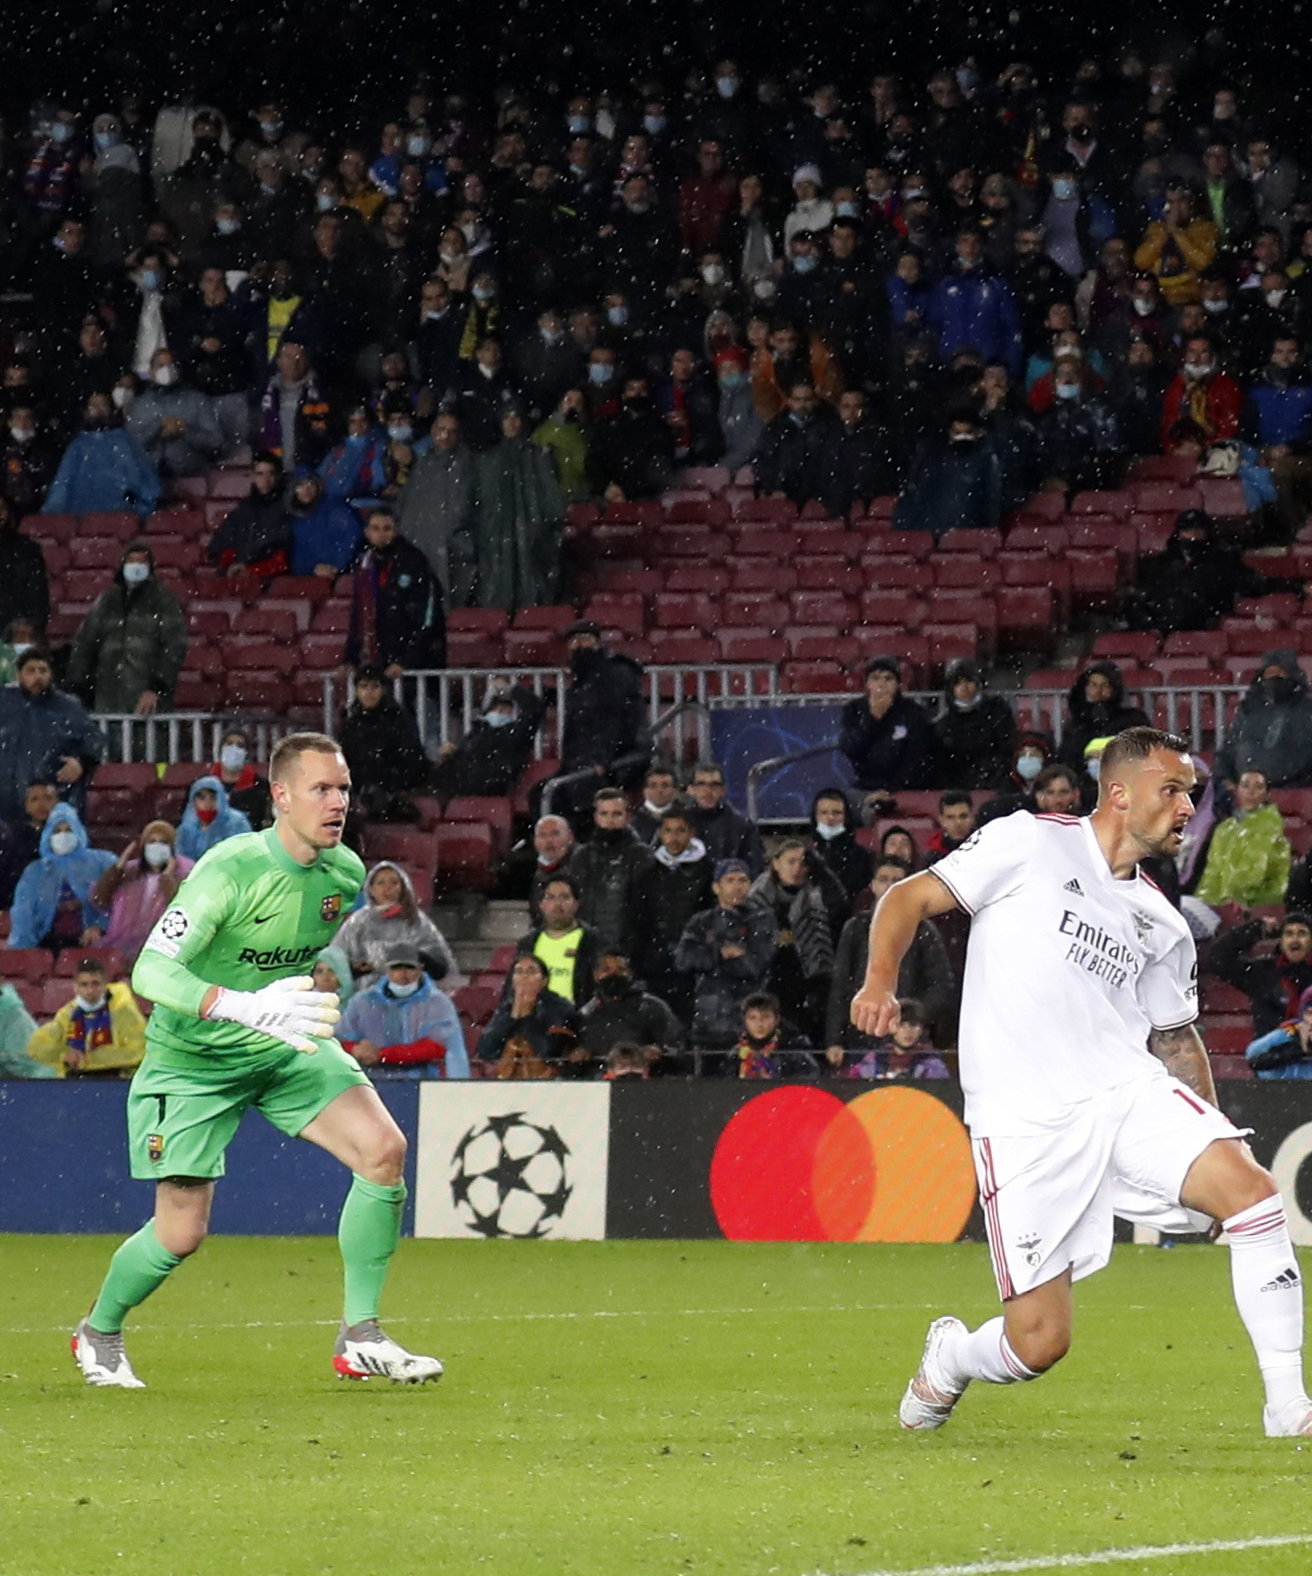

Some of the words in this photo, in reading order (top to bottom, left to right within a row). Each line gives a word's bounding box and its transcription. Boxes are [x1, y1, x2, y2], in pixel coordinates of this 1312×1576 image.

[238, 944, 331, 965] Rakute
[1058, 910, 1139, 975] Emirates
[1065, 943, 1092, 966] FLY
[1087, 956, 1128, 989] BETTER
[1260, 1279, 1301, 1292] adida
